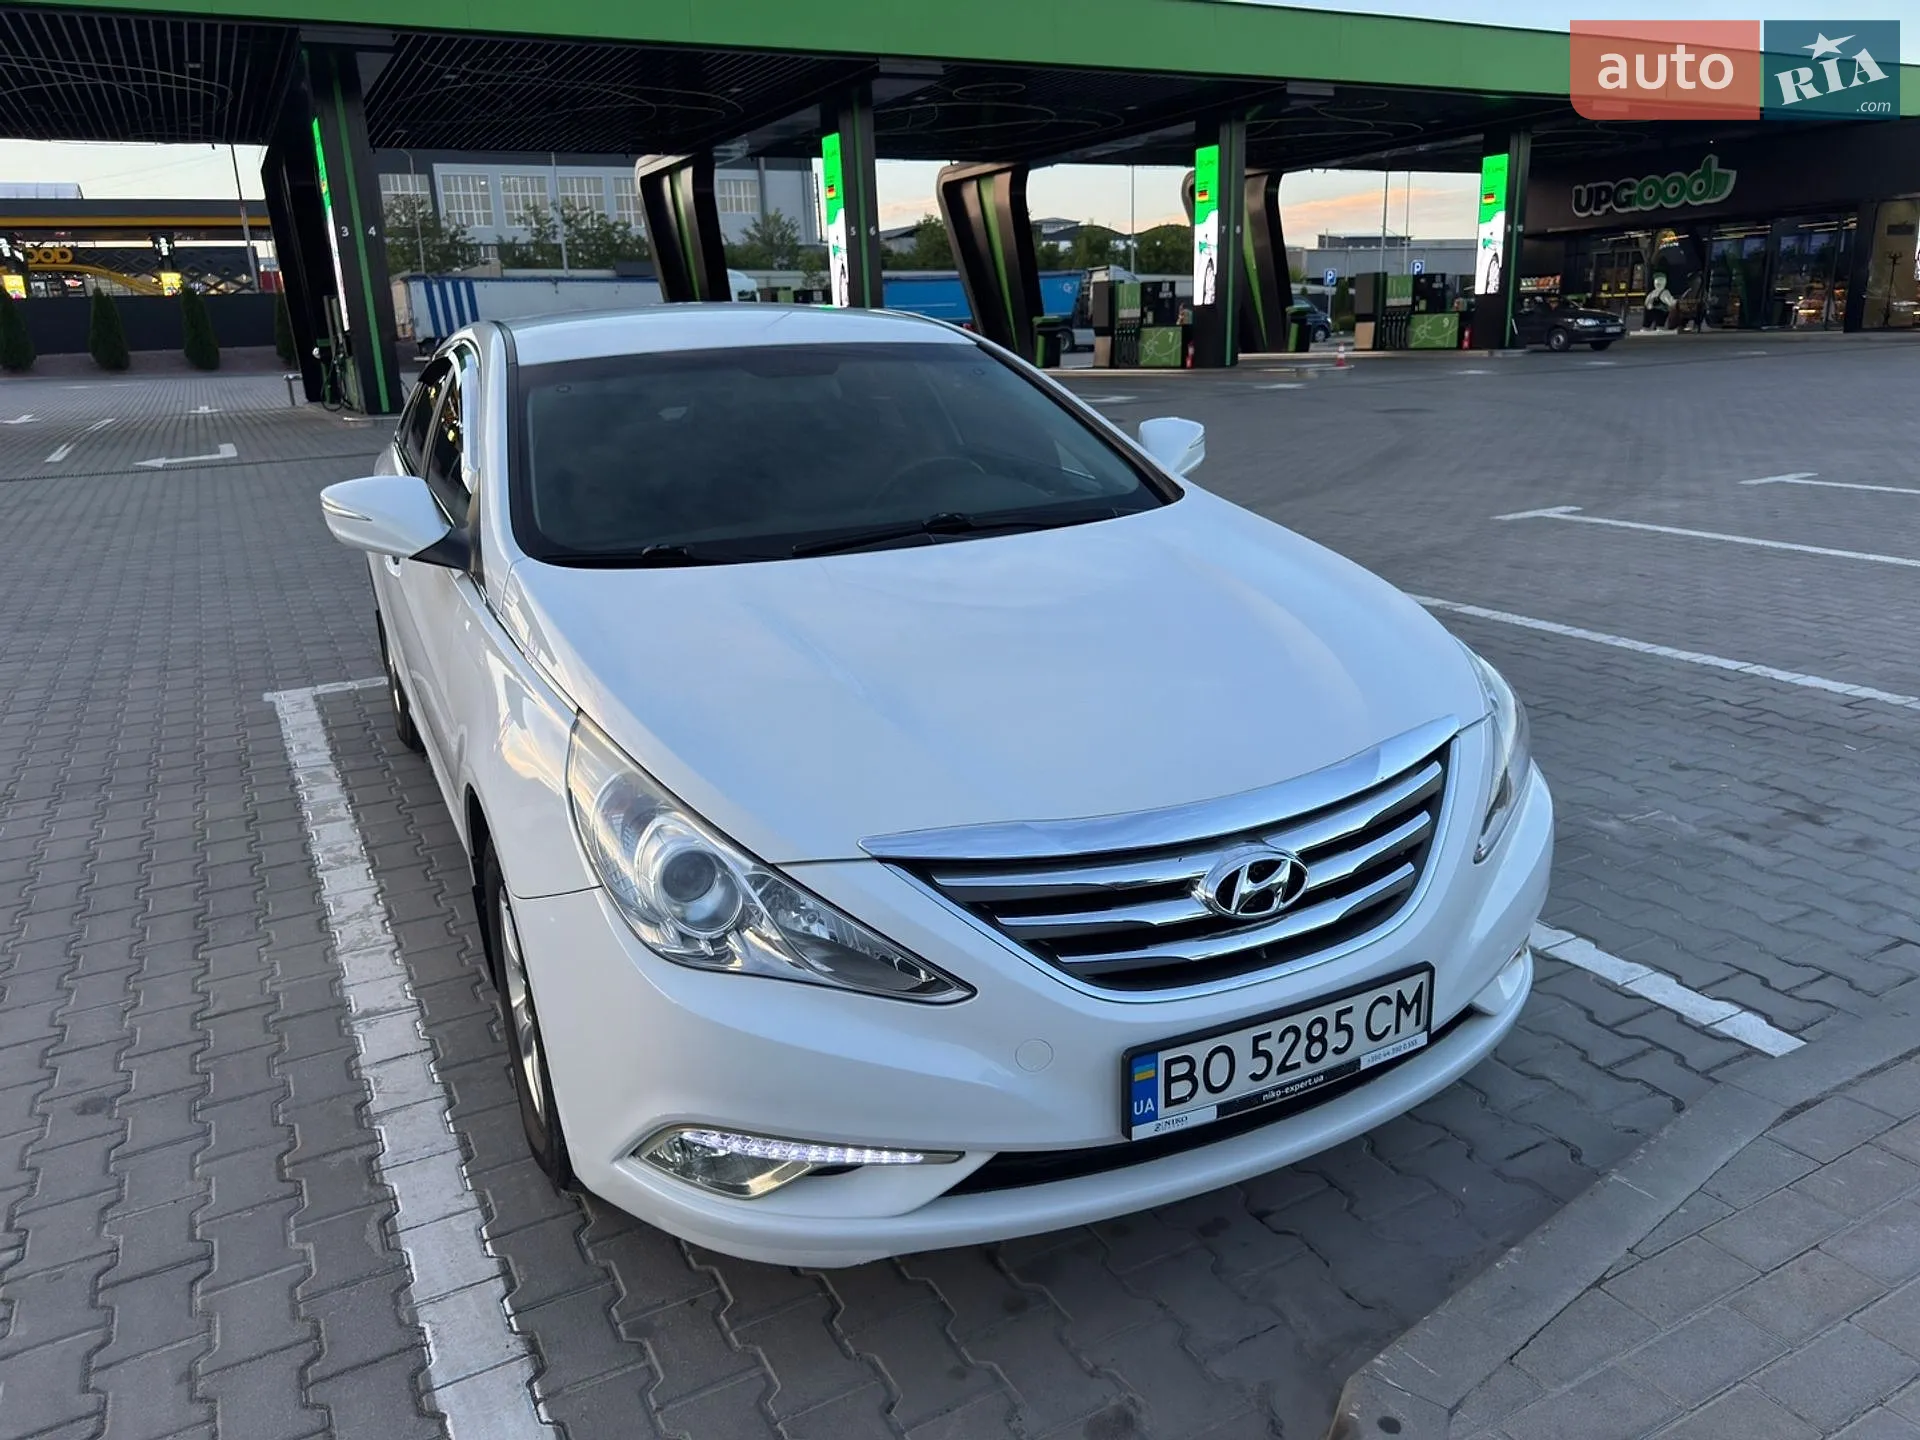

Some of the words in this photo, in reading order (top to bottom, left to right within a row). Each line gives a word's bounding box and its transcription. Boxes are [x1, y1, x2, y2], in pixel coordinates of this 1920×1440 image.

[341, 226, 349, 237] 3
[368, 226, 376, 237] 4
[1326, 270, 1334, 281] P
[1164, 1044, 1236, 1109] BO
[1248, 1006, 1354, 1082] 5285
[1365, 981, 1424, 1042] CM
[1134, 1097, 1155, 1116] UA
